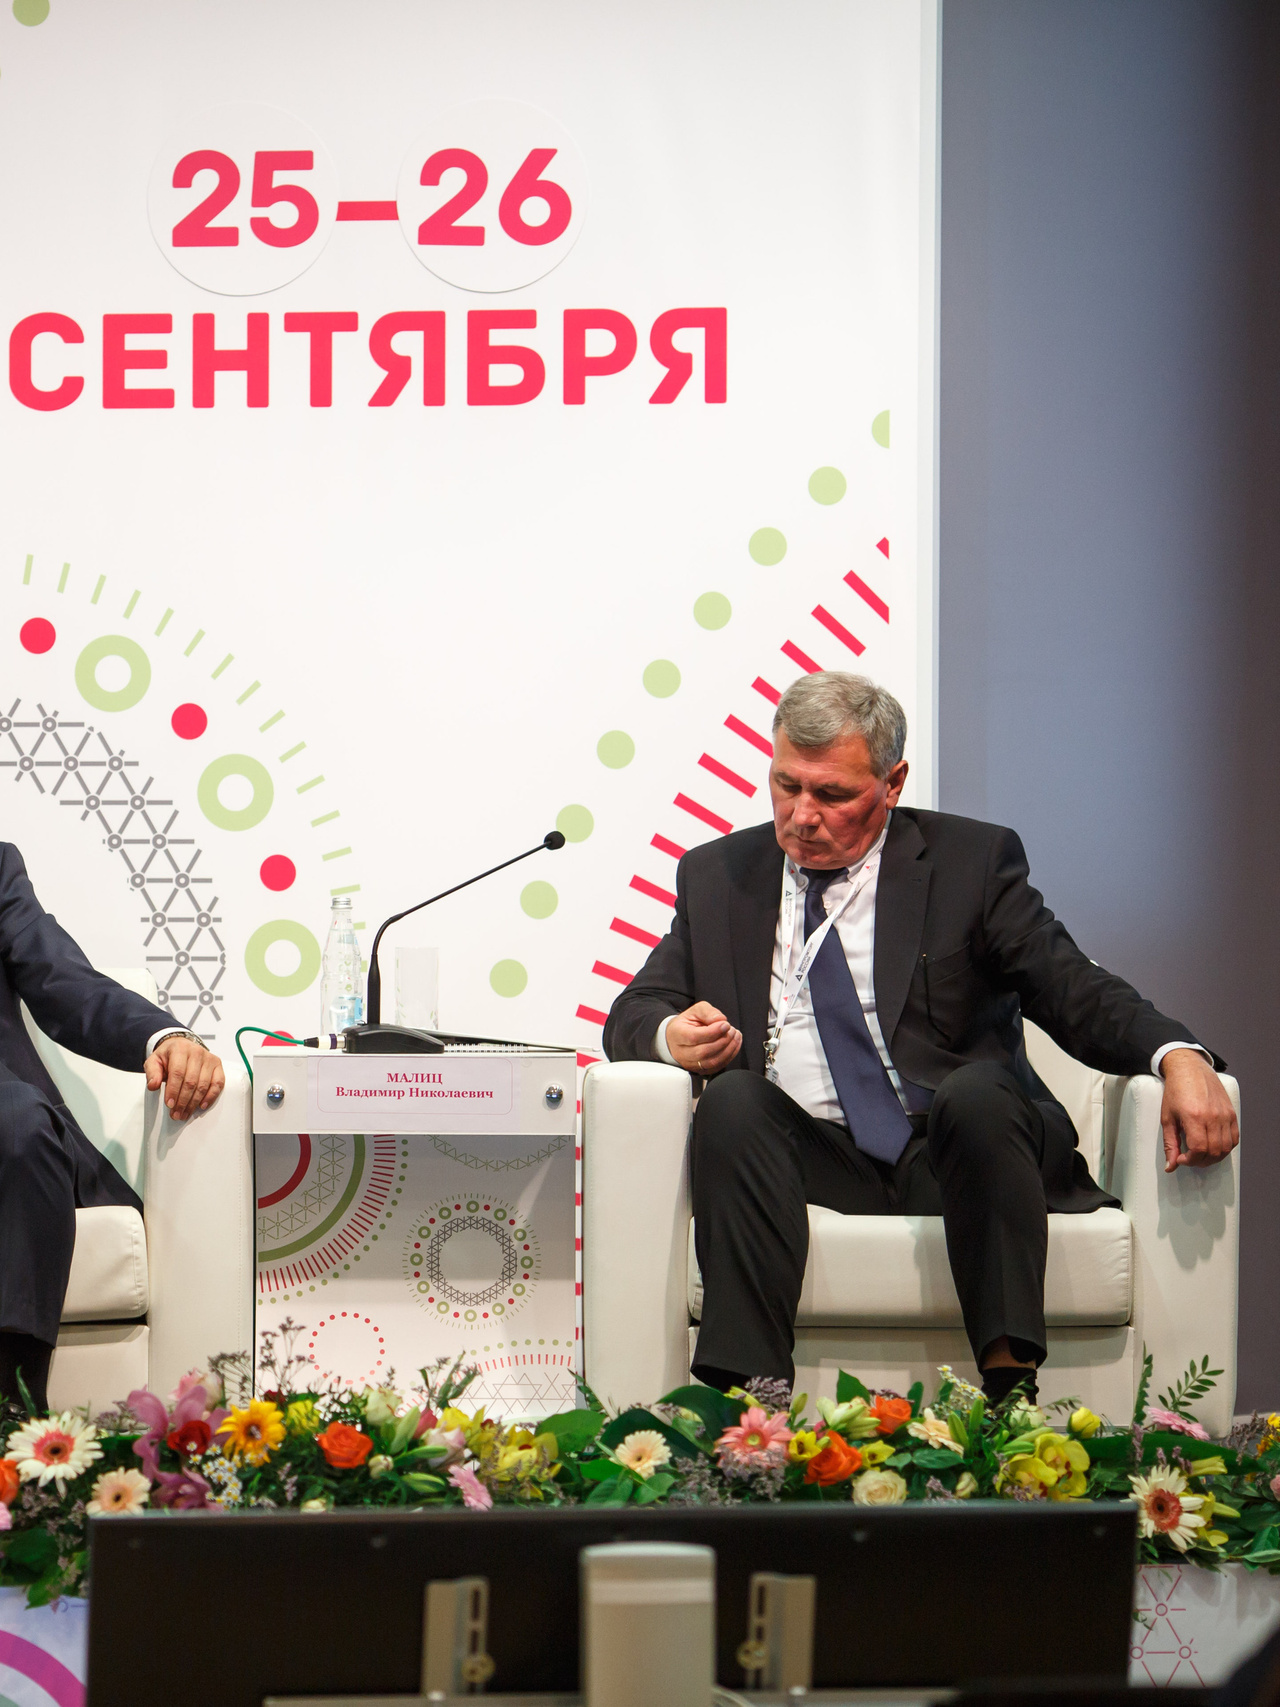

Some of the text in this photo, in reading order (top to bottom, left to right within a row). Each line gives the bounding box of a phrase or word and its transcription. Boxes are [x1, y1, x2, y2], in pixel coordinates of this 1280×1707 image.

[8, 306, 728, 412] СЕНТЯБРЯ
[386, 1072, 444, 1085] МАЛИЦ
[335, 1086, 494, 1100] Владимир Николаевич
